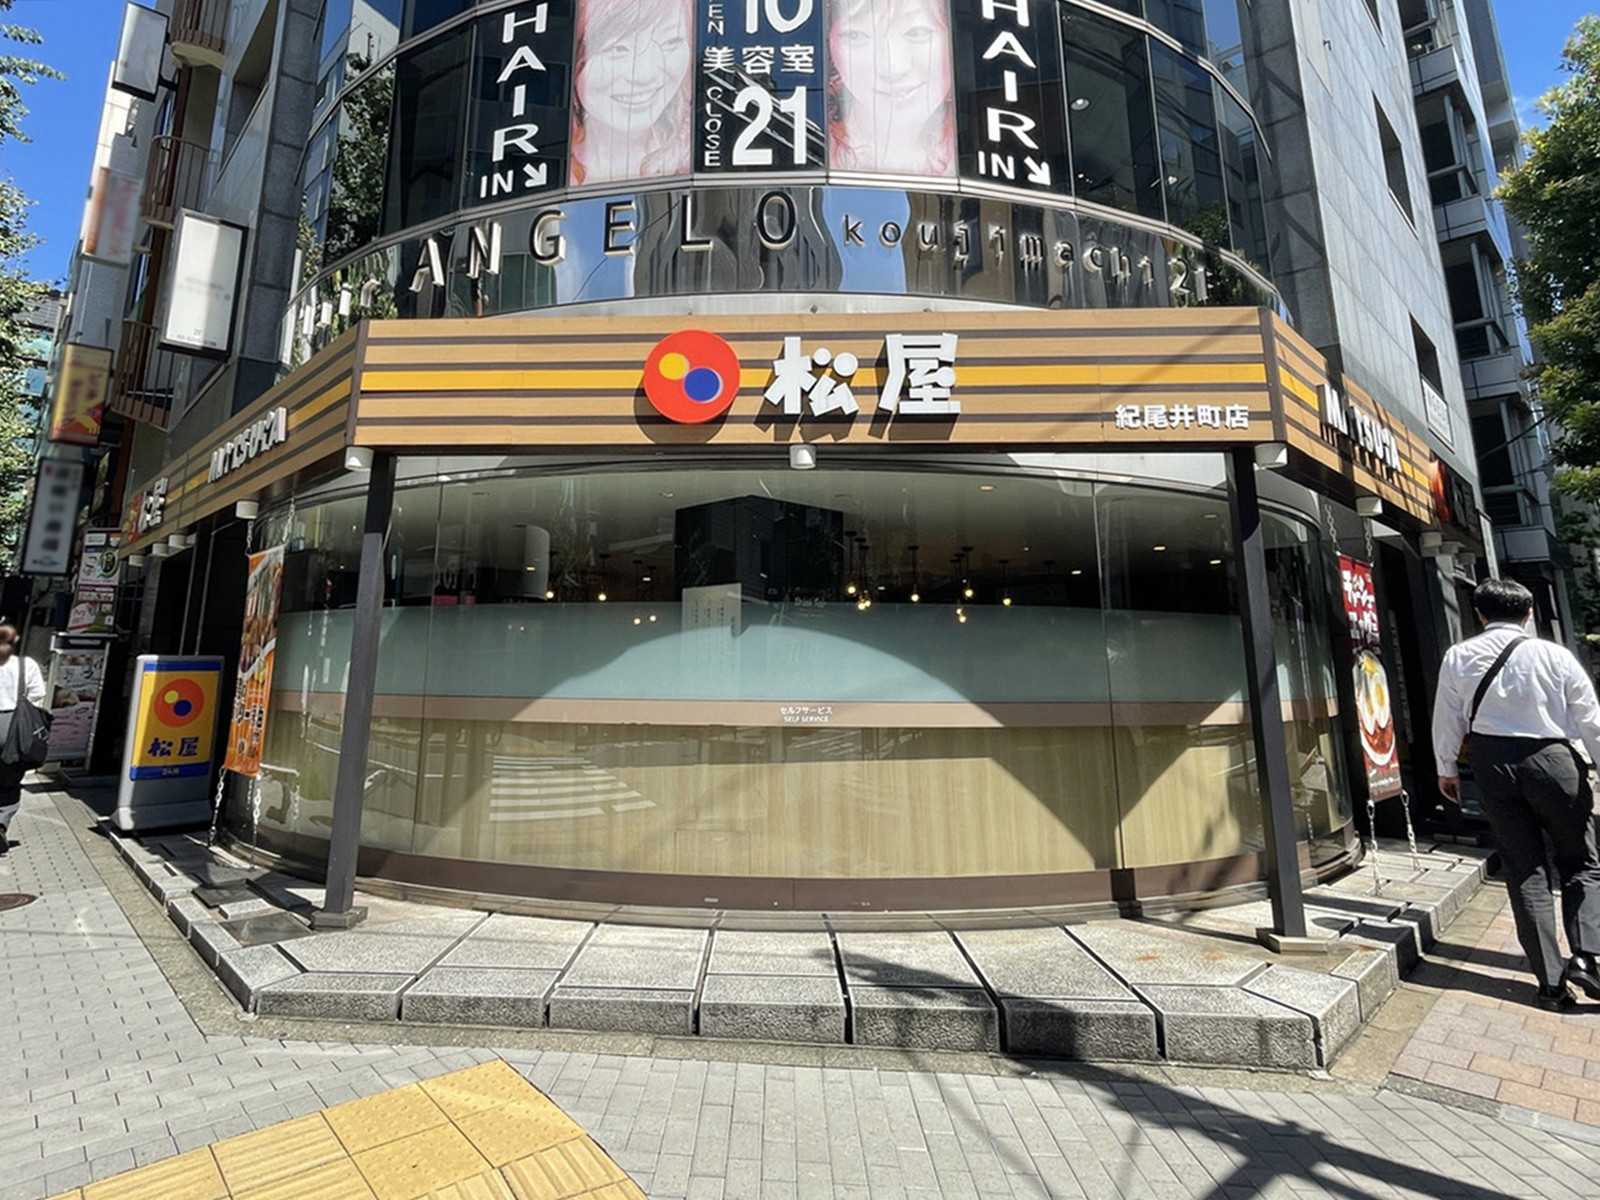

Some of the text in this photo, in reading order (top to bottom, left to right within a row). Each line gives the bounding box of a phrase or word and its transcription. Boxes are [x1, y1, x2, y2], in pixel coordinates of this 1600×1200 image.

[708, 0, 724, 35] EN
[746, 0, 813, 34] 10
[703, 44, 815, 74] 美容室
[981, 0, 1039, 149] HAIR
[492, 2, 548, 162] HAIR
[704, 86, 723, 166] CLOSE
[732, 86, 807, 165] 21
[978, 150, 1016, 180] IN
[480, 170, 514, 198] IN
[409, 190, 797, 293] ANGELO
[763, 332, 961, 417] 松屋
[1115, 404, 1249, 428] 紀尾井町店
[780, 706, 833, 715] セルフサービス
[148, 736, 199, 757] 松屋
